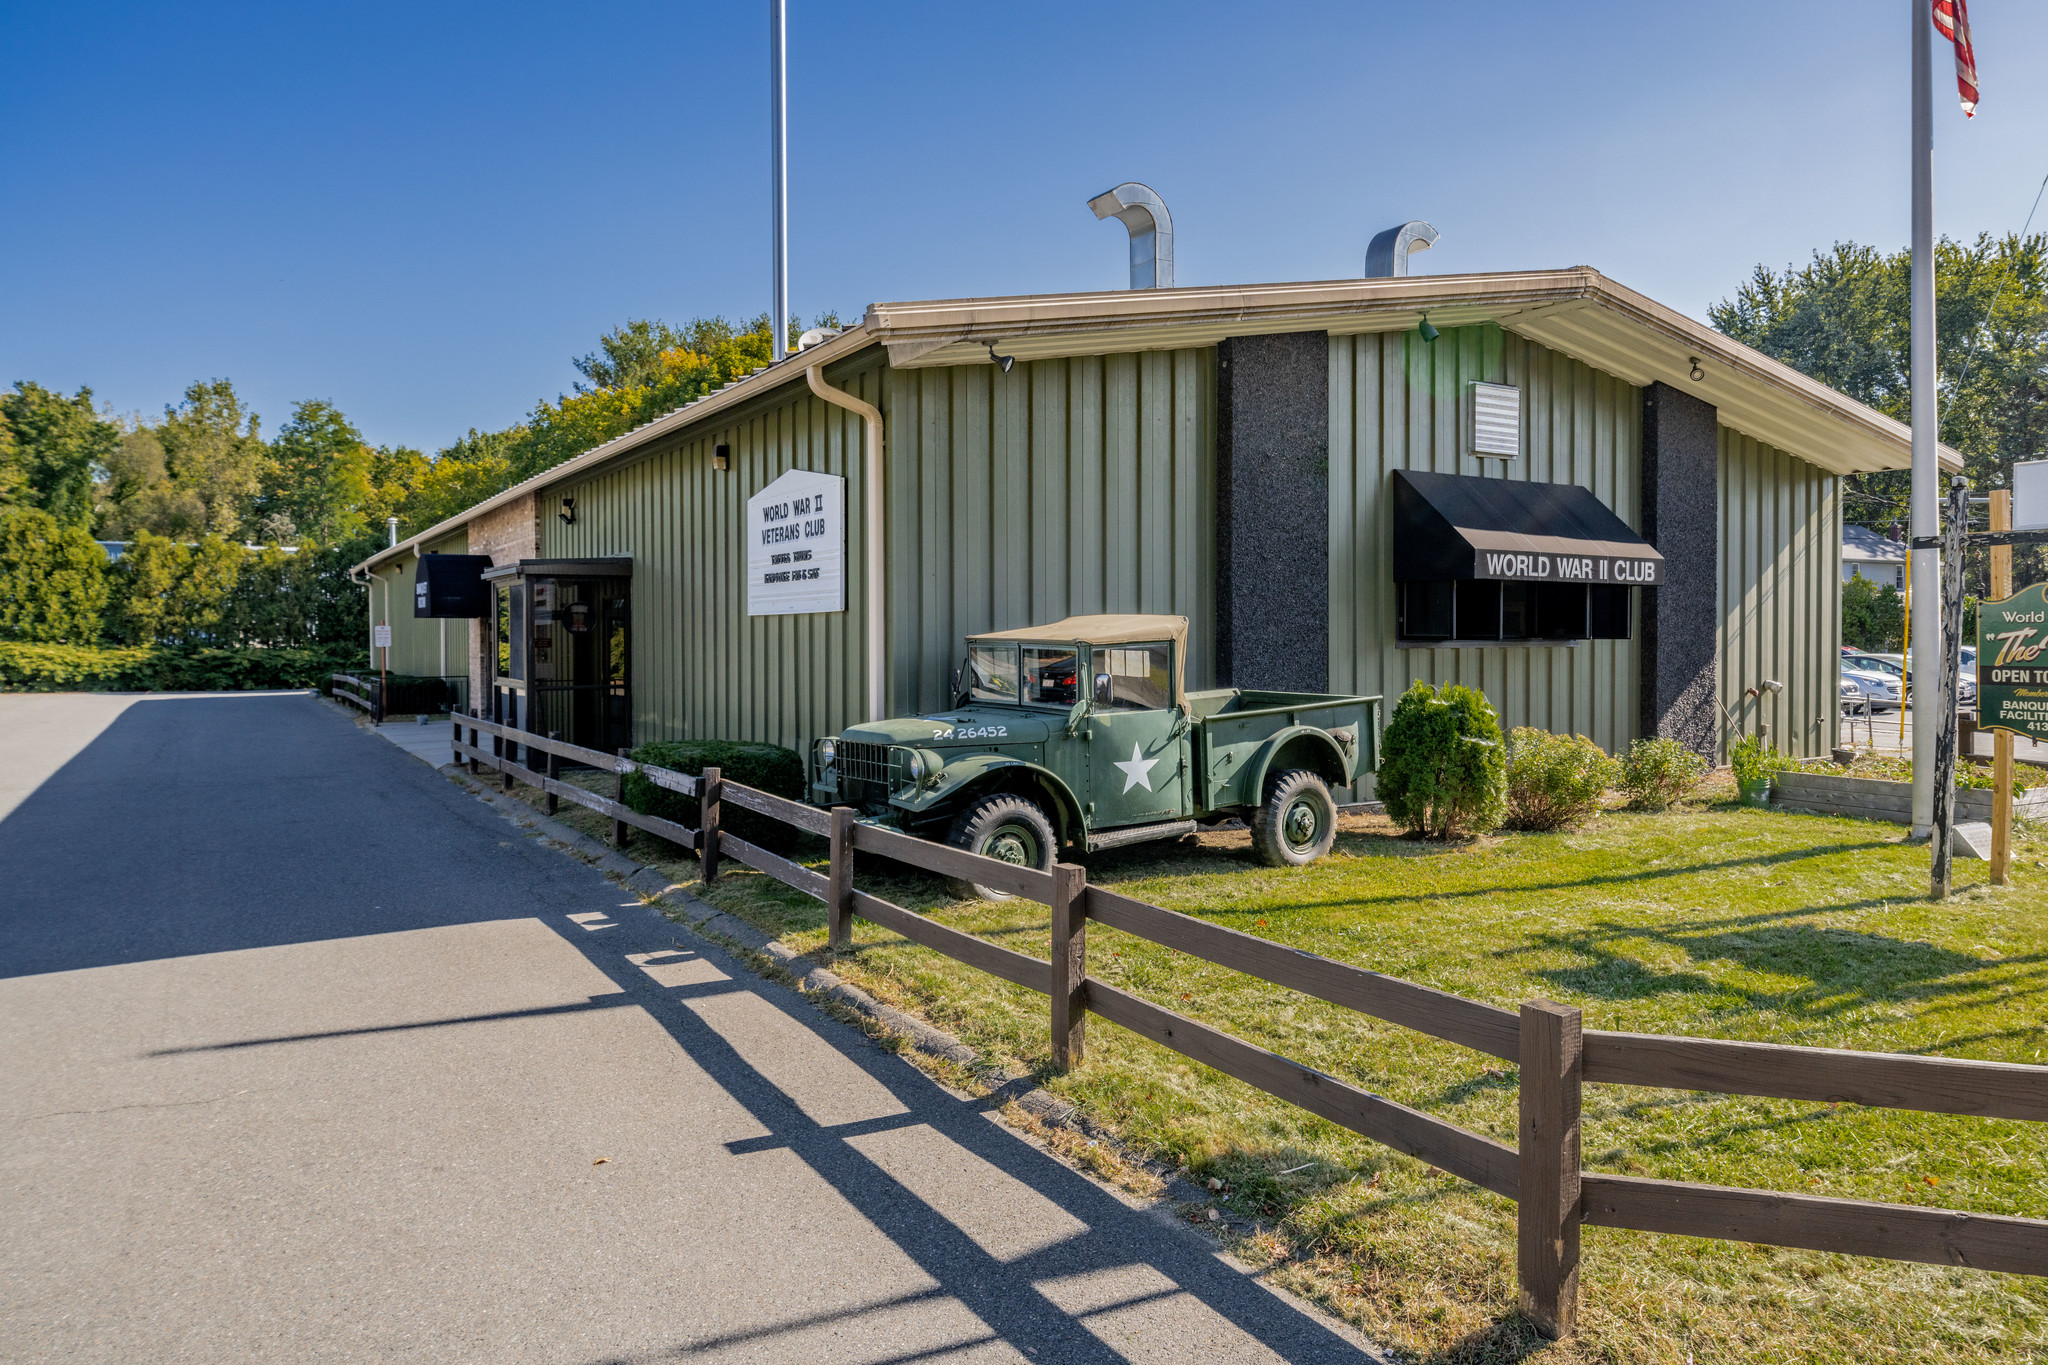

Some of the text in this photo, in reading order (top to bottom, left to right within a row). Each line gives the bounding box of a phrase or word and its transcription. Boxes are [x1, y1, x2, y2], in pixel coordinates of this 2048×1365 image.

[763, 494, 823, 522] WORLD WAR II
[762, 518, 825, 545] VETERANS CLUB
[1486, 553, 1655, 582] WORLD WAR II CLUB
[2002, 611, 2045, 623] World
[1991, 669, 2030, 683] OPEN
[2002, 700, 2048, 711] BANQU
[932, 725, 1008, 740] 24 26452
[2027, 721, 2048, 731] 413
